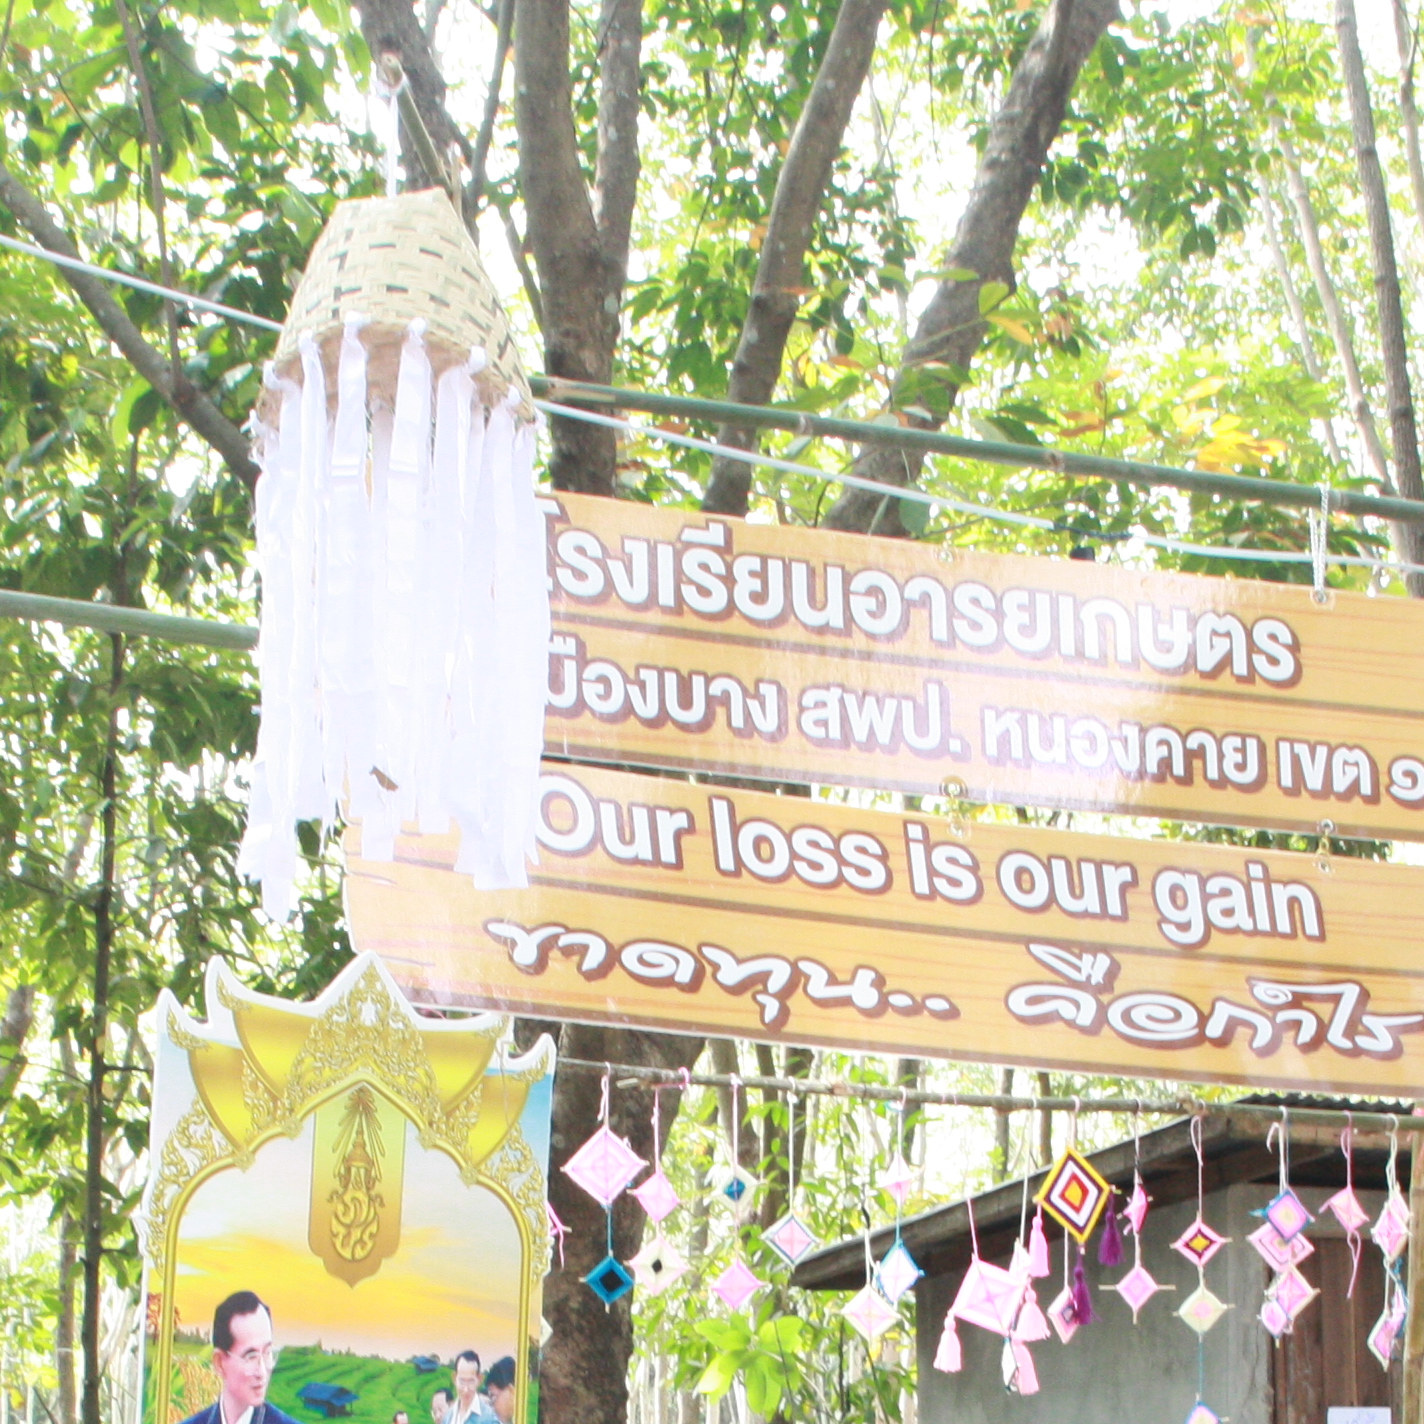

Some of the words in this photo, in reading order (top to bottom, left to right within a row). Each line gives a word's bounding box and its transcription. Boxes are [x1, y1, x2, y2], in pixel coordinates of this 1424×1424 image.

[801, 682, 963, 754] สพป.
[984, 708, 1259, 784] หนองคาย
[1280, 741, 1372, 796] เขต
[536, 774, 689, 865] Our
[711, 797, 887, 890] loss
[906, 823, 977, 901] is
[998, 852, 1134, 916] our
[1156, 864, 1320, 945] gain
